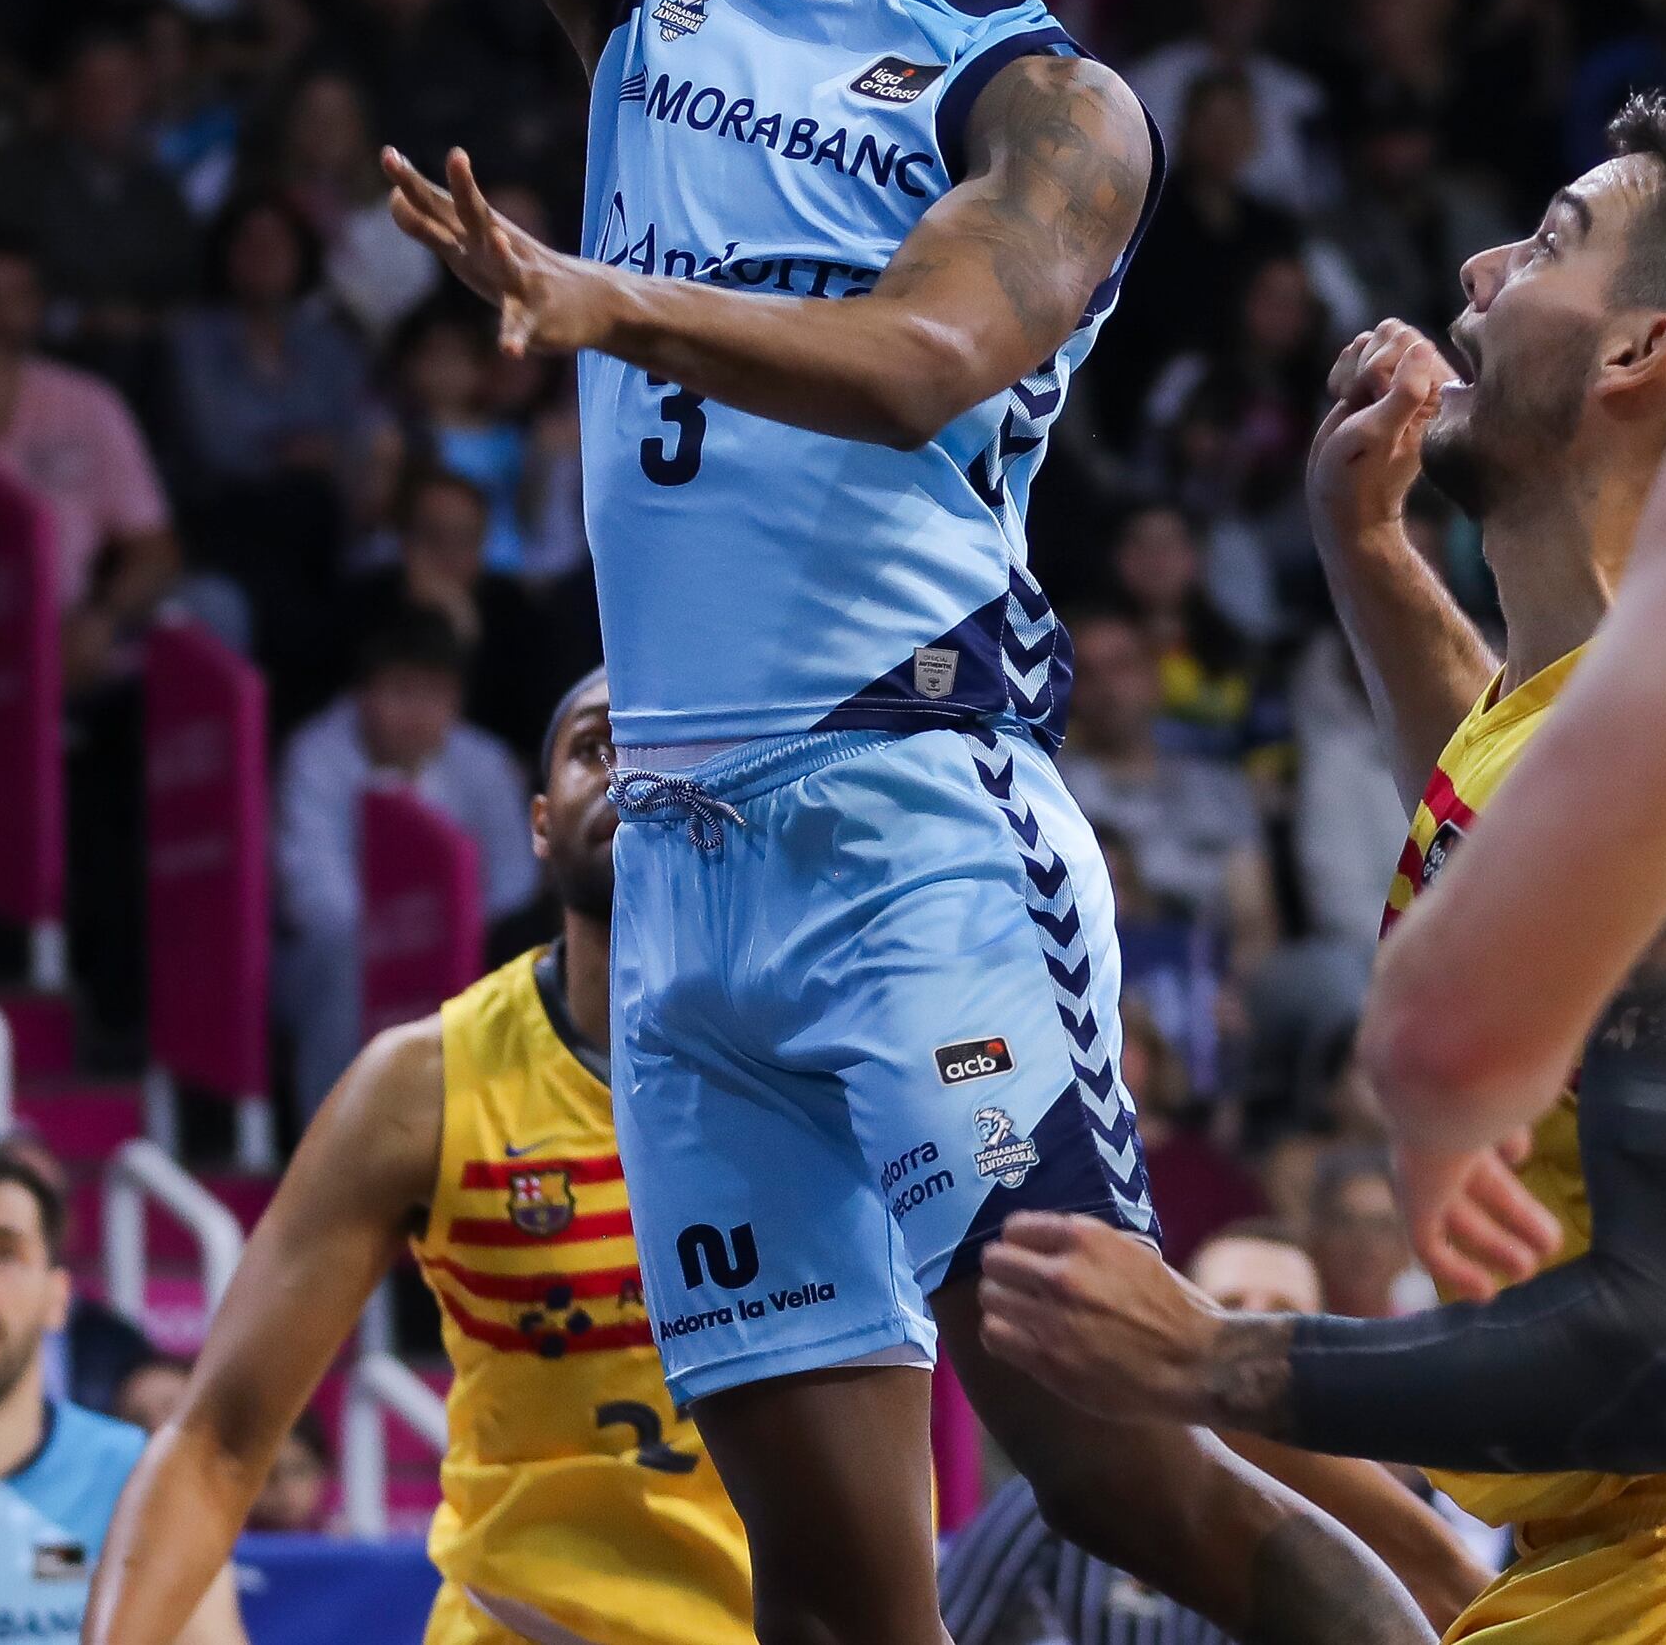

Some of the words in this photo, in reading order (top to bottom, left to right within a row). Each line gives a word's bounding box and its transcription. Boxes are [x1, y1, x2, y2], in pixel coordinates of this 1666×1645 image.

[653, 7, 701, 34] ANDORRA
[871, 67, 904, 85] liga
[860, 80, 922, 100] endesa
[645, 73, 934, 199] MORABANC
[640, 369, 708, 488] 3
[945, 1055, 997, 1080] acb
[976, 1139, 1032, 1163] MORABANC
[979, 1149, 1036, 1176] ANDORRA
[737, 1299, 766, 1321] la
[768, 1283, 836, 1312] Vella
